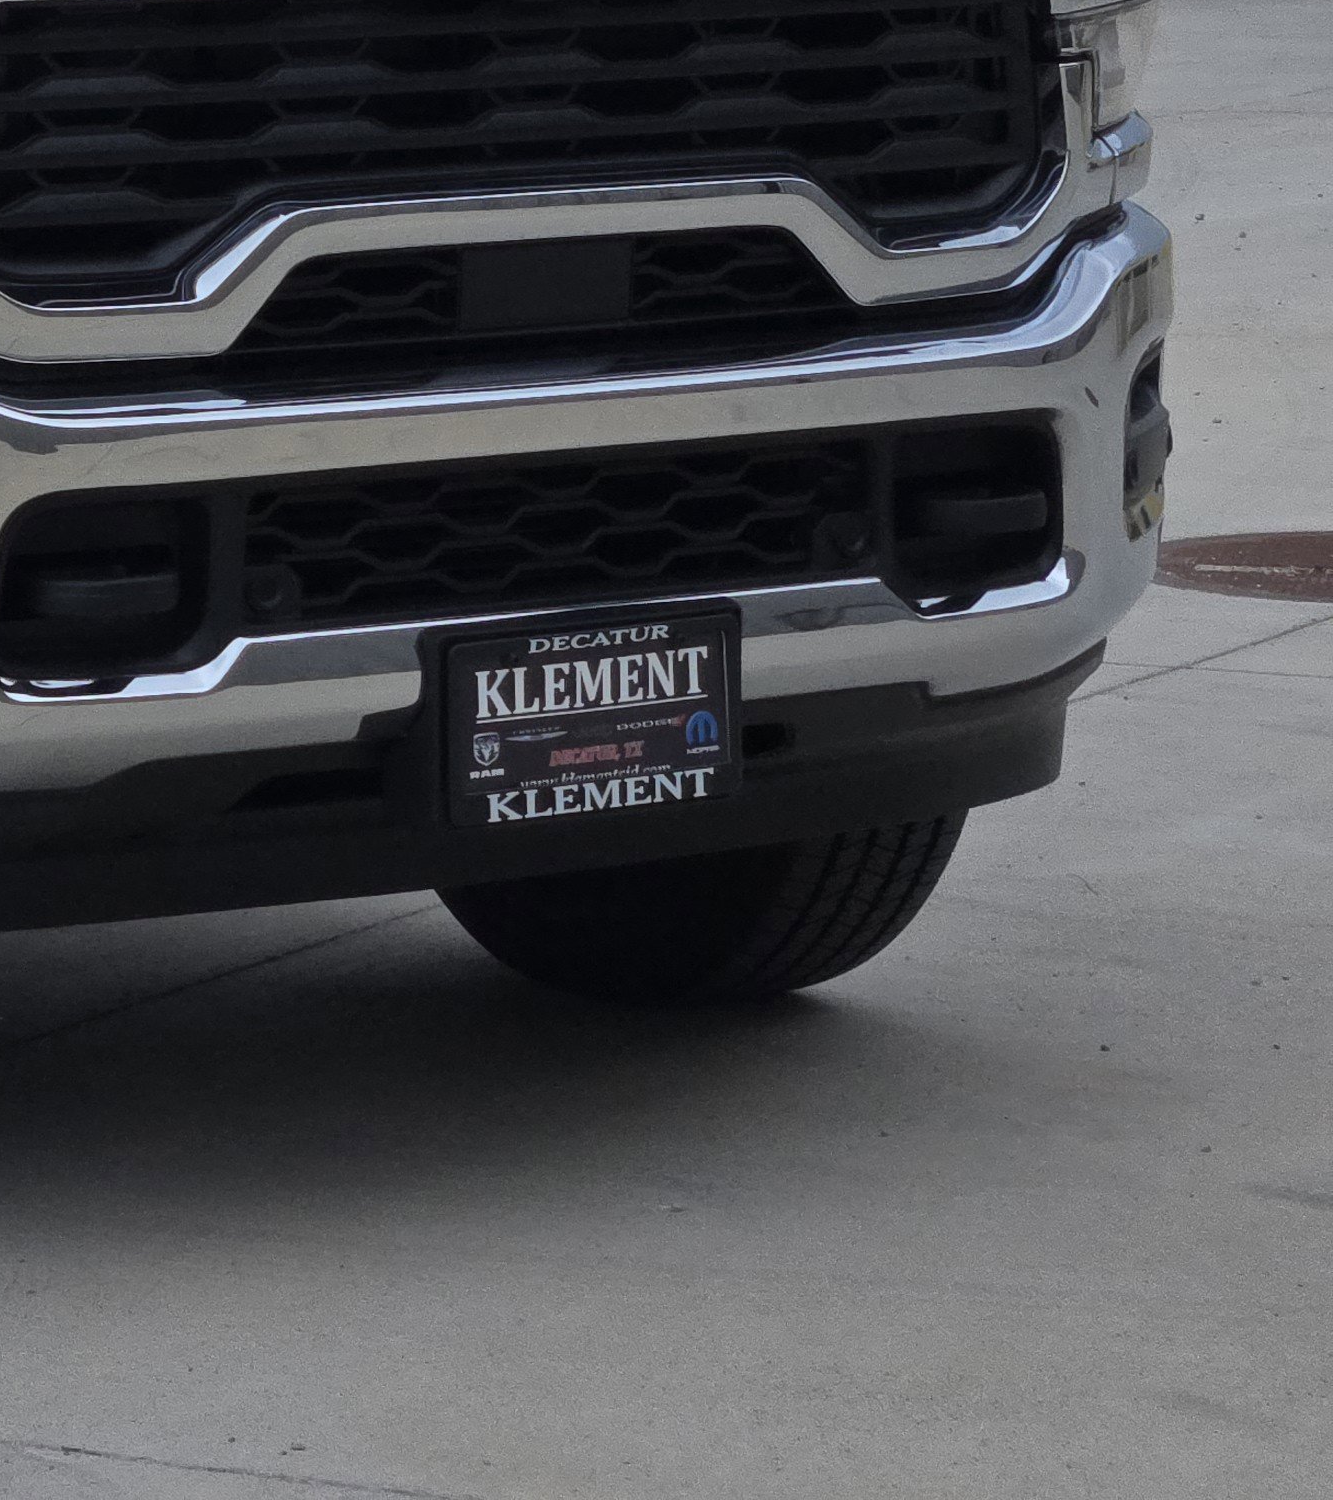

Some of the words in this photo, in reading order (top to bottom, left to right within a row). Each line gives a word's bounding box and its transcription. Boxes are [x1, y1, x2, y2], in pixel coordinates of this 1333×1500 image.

[528, 624, 670, 654] DECATUR
[474, 646, 709, 720] KLEMENT
[469, 767, 505, 780] RAM
[486, 767, 715, 824] KLEMENT
